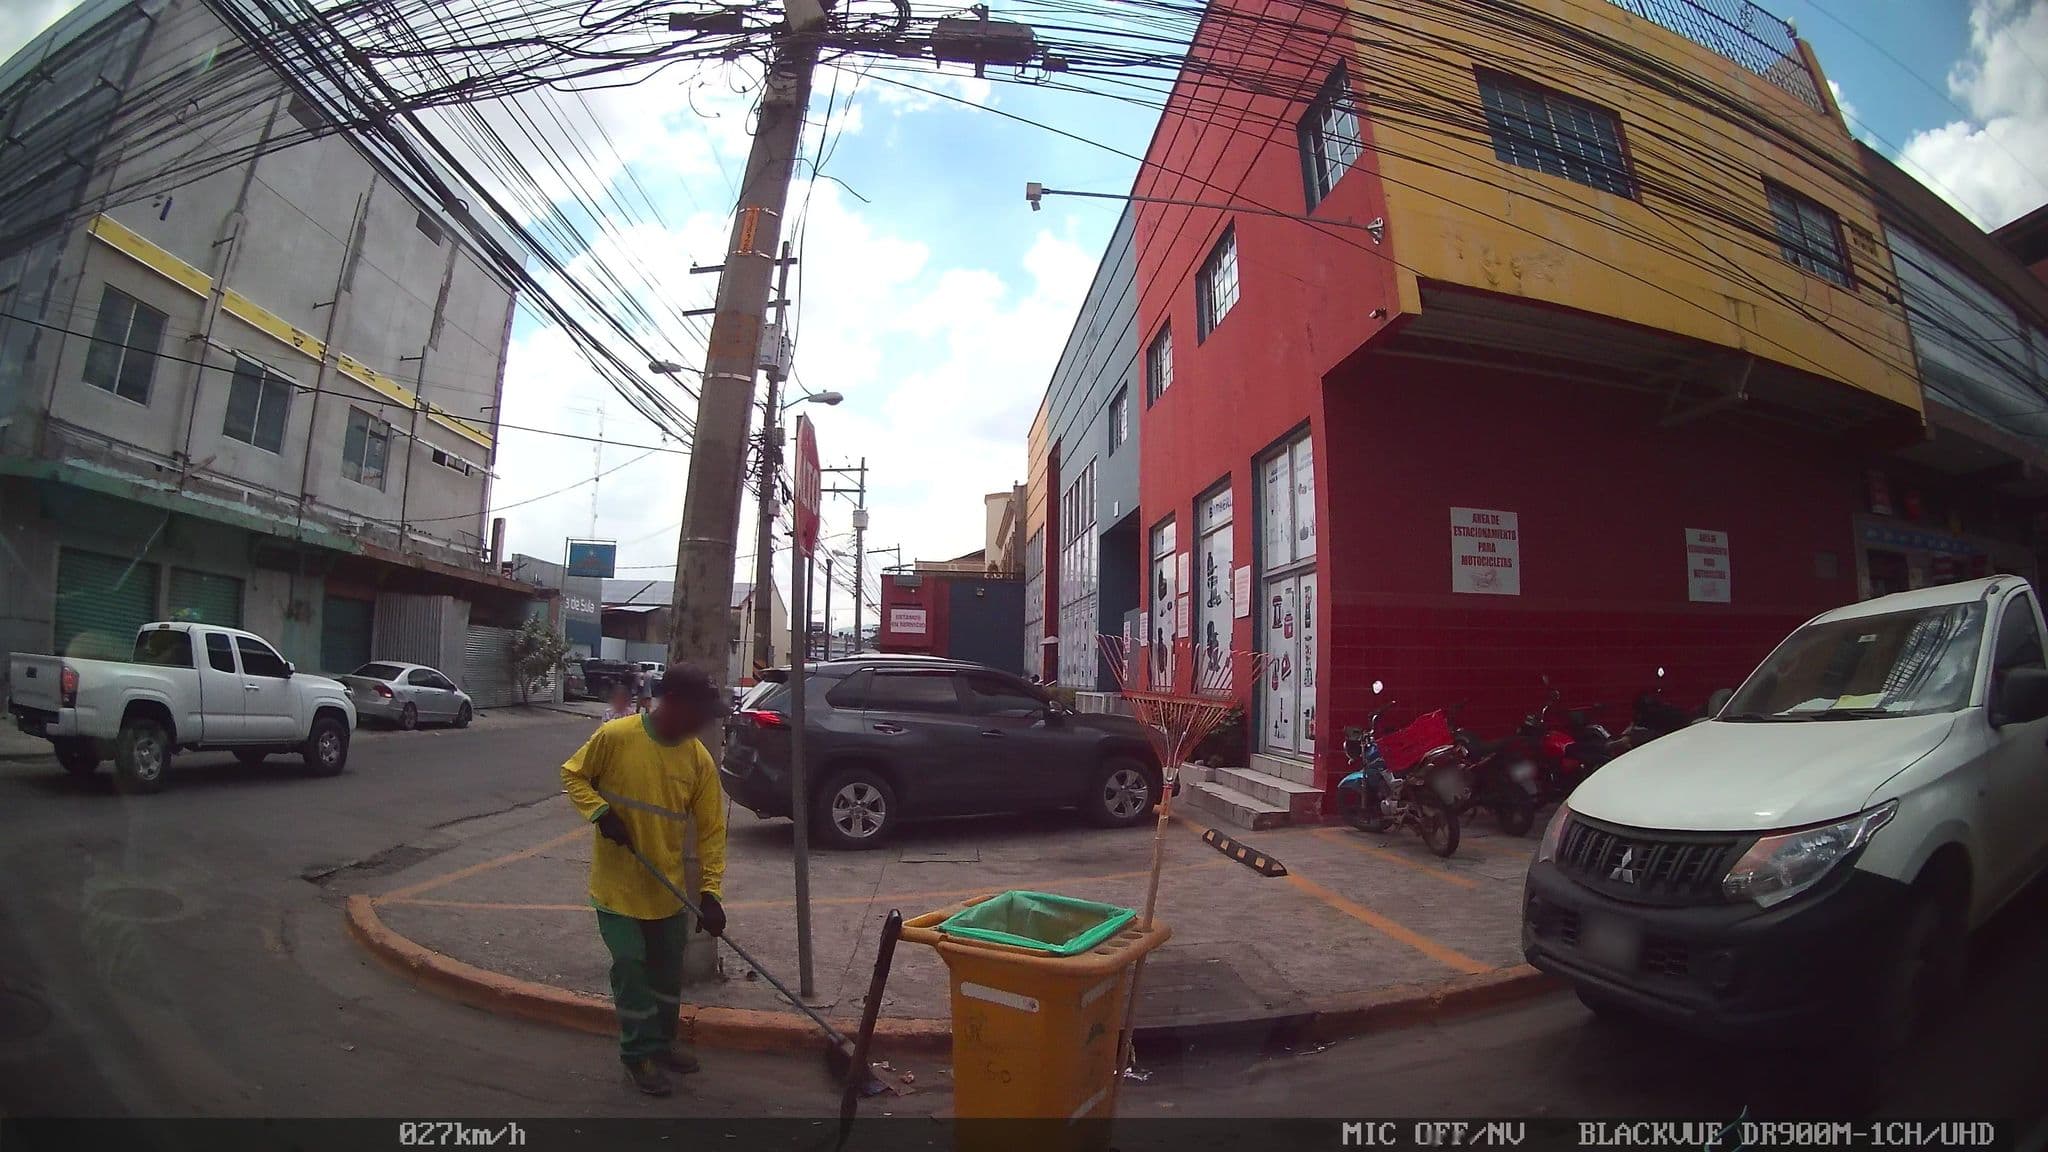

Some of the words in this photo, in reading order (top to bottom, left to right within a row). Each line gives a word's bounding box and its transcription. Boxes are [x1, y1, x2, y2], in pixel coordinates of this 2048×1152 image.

[1472, 513, 1490, 525] AREA
[1491, 515, 1500, 526] DE
[1453, 526, 1517, 541] ESTACIONAMIENTO
[1478, 542, 1496, 553] PARA
[1461, 555, 1513, 568] MOTOCICLETAS
